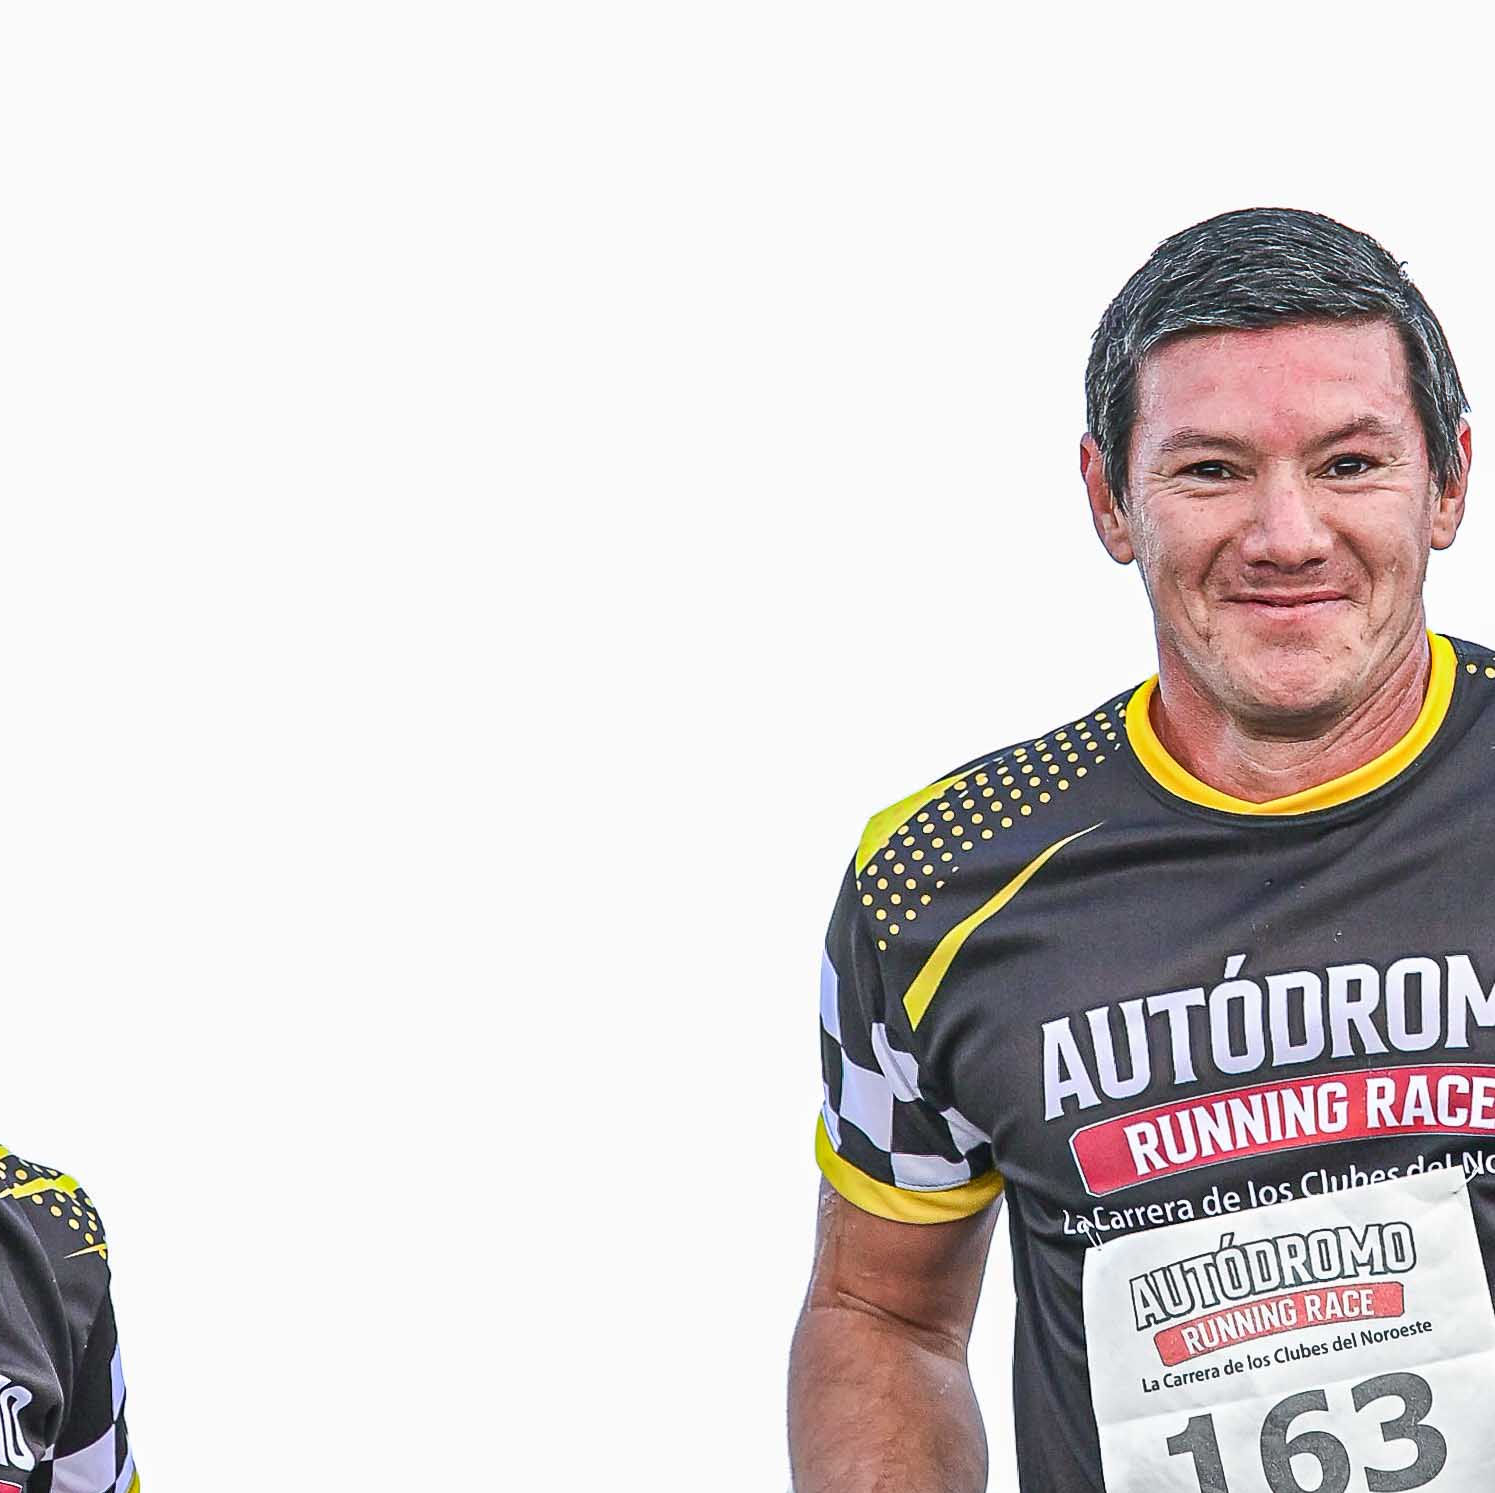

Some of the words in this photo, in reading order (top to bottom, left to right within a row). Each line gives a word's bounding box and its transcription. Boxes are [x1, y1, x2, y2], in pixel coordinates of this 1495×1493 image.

[1122, 1081, 1349, 1176] RUNNING
[1365, 1074, 1495, 1130] RACE
[1093, 1198, 1194, 1231] Carrera
[1203, 1186, 1241, 1216] de
[1248, 1180, 1294, 1206] los
[1301, 1164, 1399, 1199] Clubes
[1129, 1221, 1417, 1331] AUTÓDROMO
[1142, 1377, 1160, 1393] La
[1163, 1364, 1221, 1389] Carrera
[1224, 1359, 1244, 1376] de
[1248, 1354, 1271, 1371] los
[1274, 1341, 1329, 1365] Clubes
[1333, 1334, 1357, 1353] del
[1360, 1319, 1432, 1348] Noroeste
[1181, 1298, 1297, 1356] RUNNING
[1305, 1289, 1375, 1323] RACE
